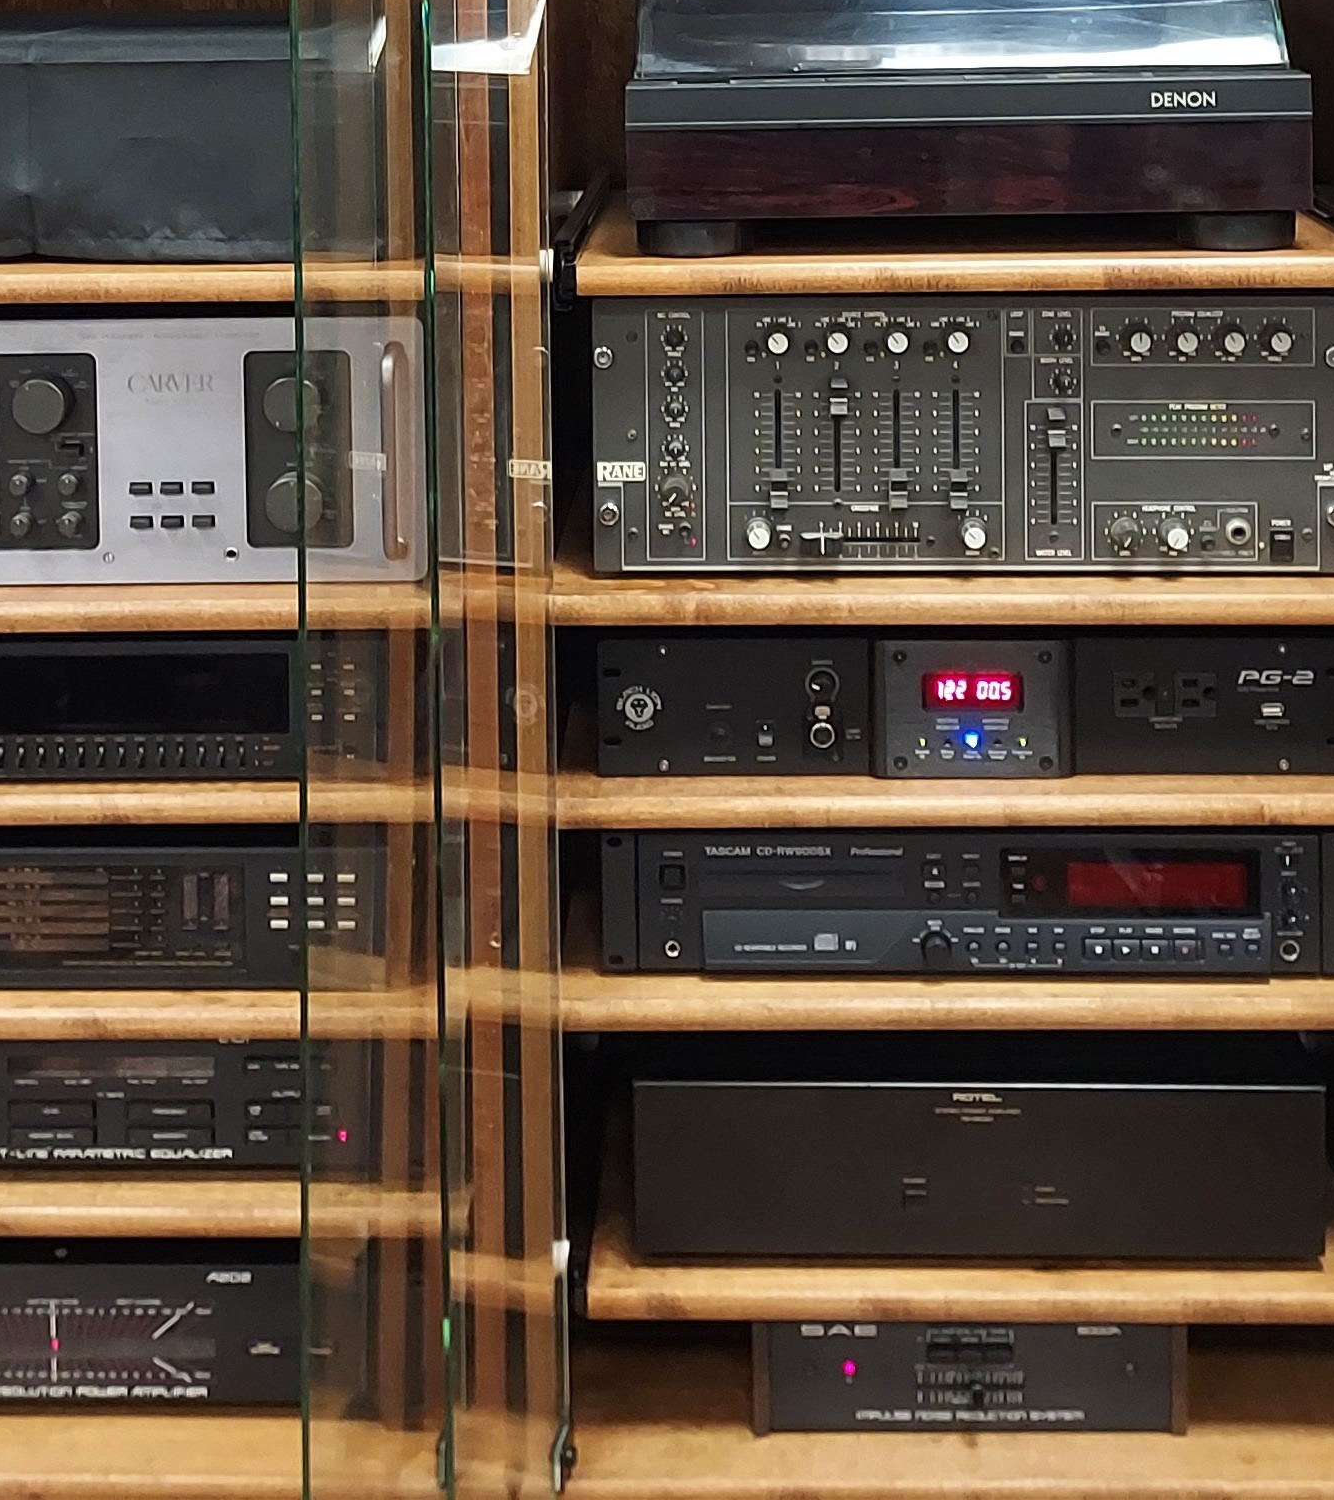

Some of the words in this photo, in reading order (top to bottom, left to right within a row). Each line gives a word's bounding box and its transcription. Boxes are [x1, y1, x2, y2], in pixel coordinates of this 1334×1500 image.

[1150, 91, 1217, 108] DENON
[127, 373, 214, 393] CARVER
[598, 462, 645, 481] RANE
[1237, 669, 1315, 685] PG-2
[704, 846, 751, 856] TASCAM
